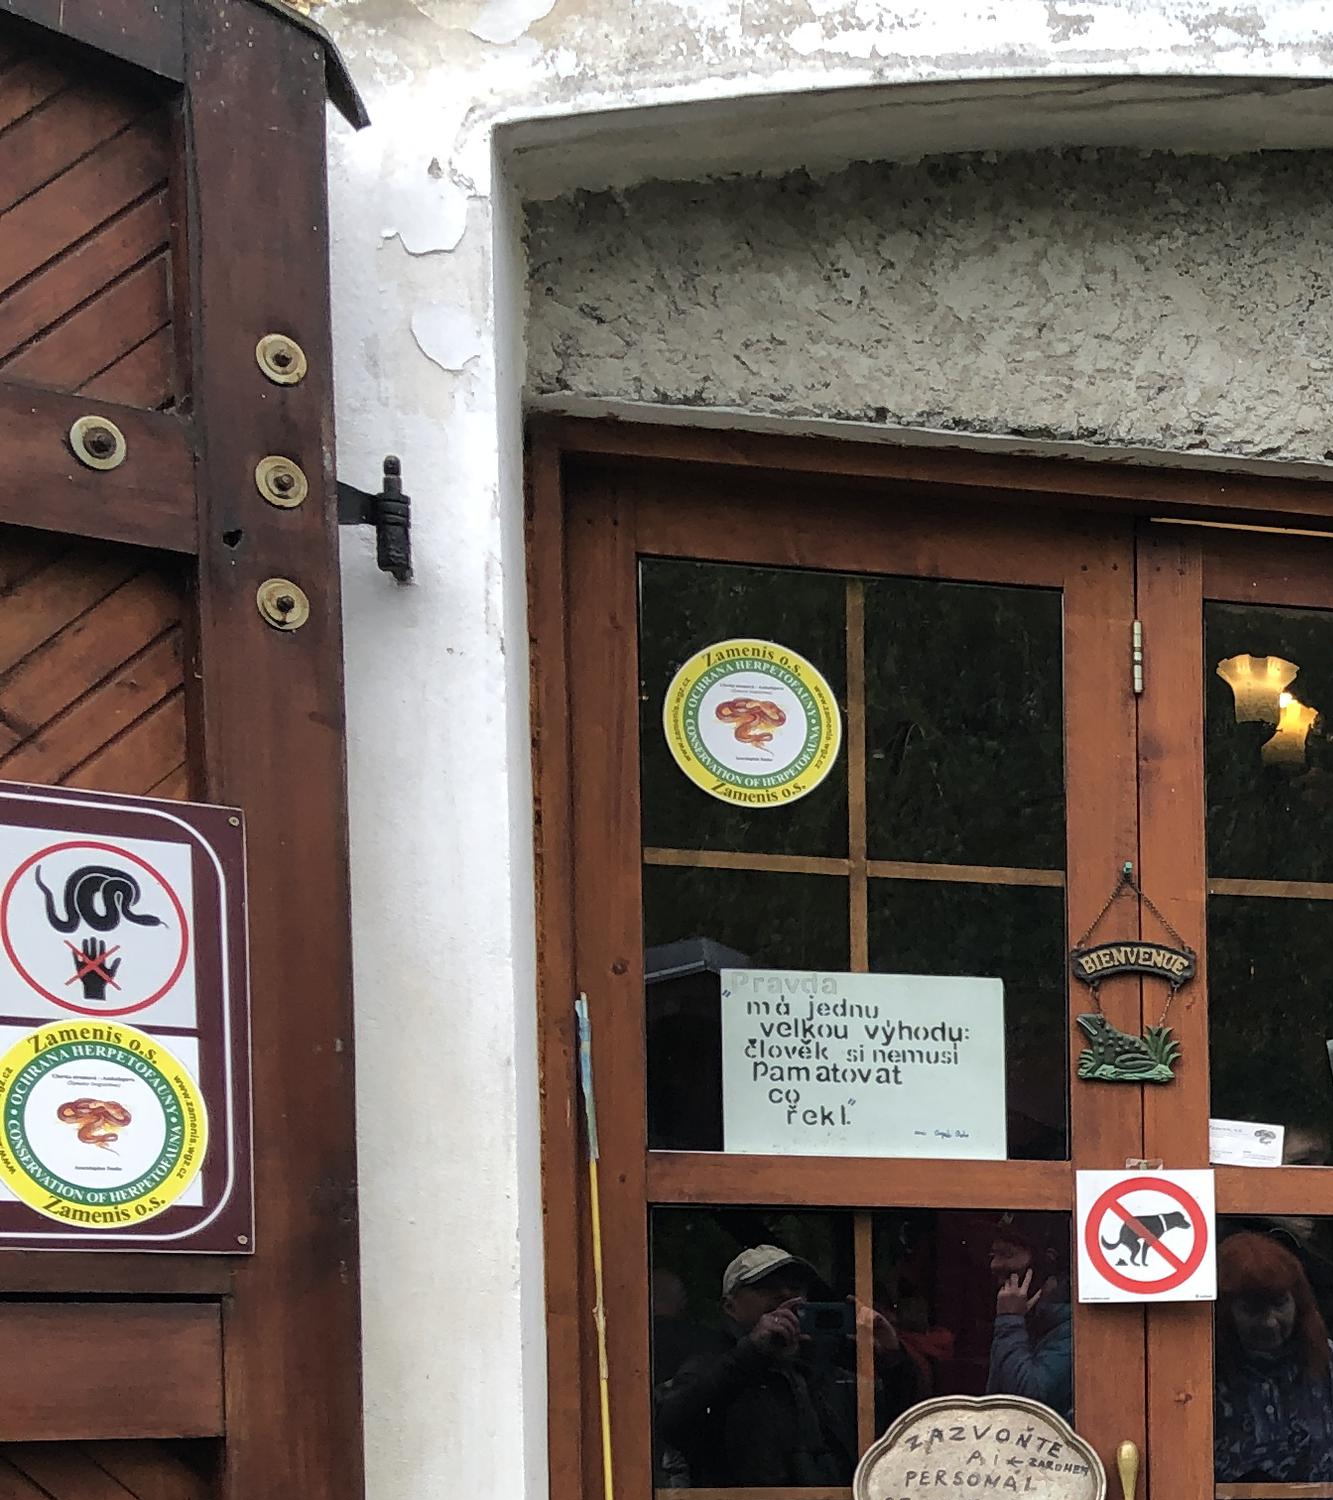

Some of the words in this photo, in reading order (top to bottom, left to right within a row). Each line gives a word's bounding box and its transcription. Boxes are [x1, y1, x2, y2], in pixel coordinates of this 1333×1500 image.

[702, 646, 774, 668] Zamenis
[688, 663, 734, 708] OCHRANA
[736, 660, 817, 720] HERPETOFAUNY
[686, 721, 742, 785] CONSERVATION
[744, 777, 760, 788] OF
[763, 725, 820, 787] HERPETOFAUNA
[711, 779, 779, 803] Zamenis
[1079, 946, 1189, 976] BIENVENUE
[747, 995, 790, 1016] má
[807, 995, 879, 1021] jednu
[760, 1018, 848, 1039] velkou
[28, 1026, 122, 1054] Zamenis
[129, 1039, 157, 1064] o.s.
[744, 1038, 829, 1060] člověk
[846, 1044, 864, 1062] si
[12, 1049, 70, 1105] OCHRANA
[72, 1044, 178, 1118] HERPETOFAUNY
[768, 1087, 800, 1104] co
[8, 1119, 87, 1200] CONSERVATION
[86, 1191, 108, 1202] OF
[108, 1125, 182, 1202] HERPETOFAUNA
[43, 1195, 131, 1224] Zamenis
[135, 1196, 166, 1217] o.s.
[905, 1424, 1063, 1459] ZAZVOŇTE
